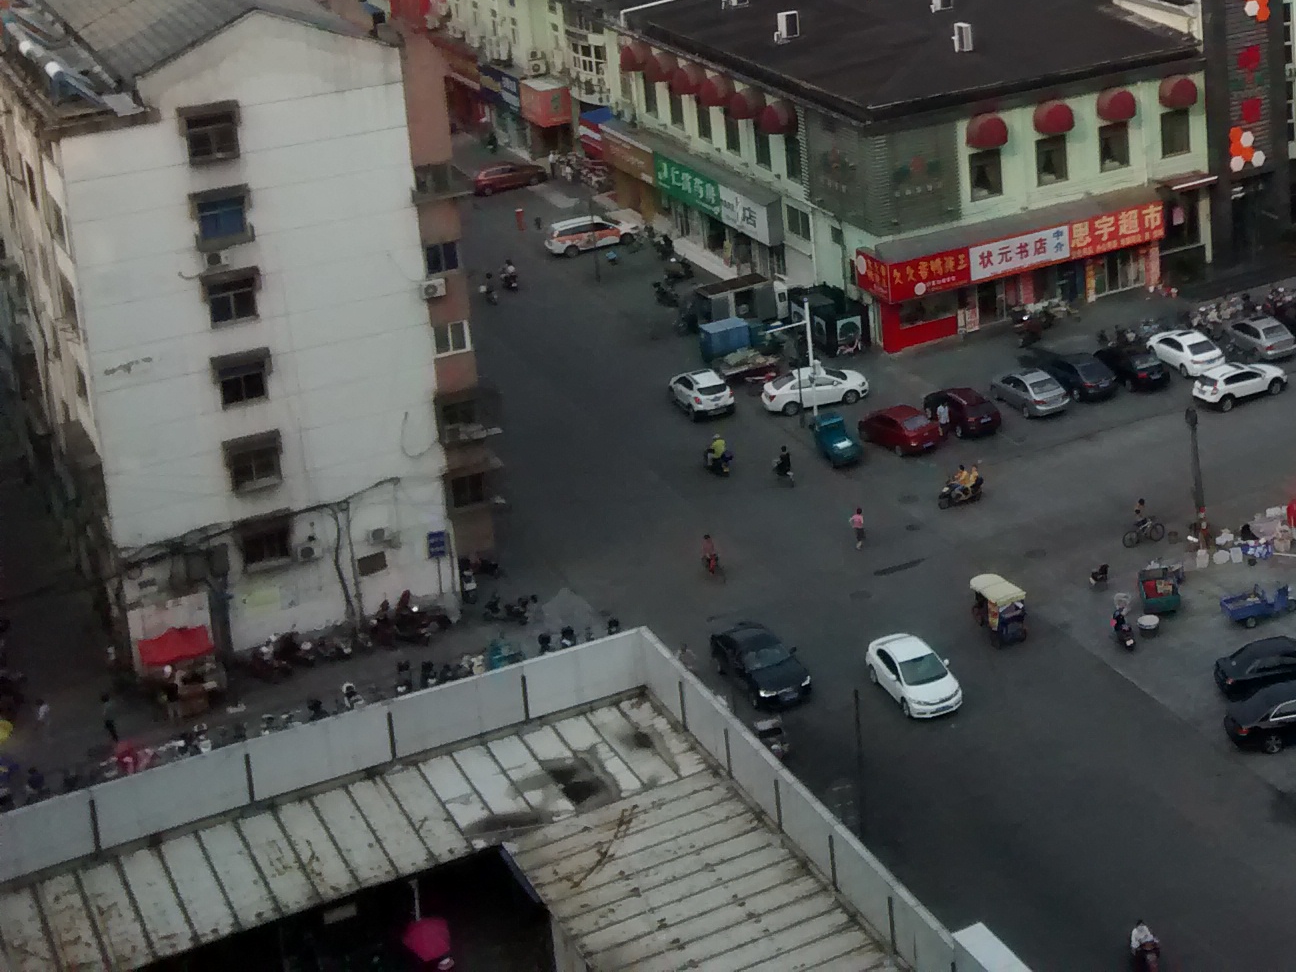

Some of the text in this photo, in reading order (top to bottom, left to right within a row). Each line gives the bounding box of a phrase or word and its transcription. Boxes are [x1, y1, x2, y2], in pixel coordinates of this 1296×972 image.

[978, 237, 1048, 269] 状元书店
[1052, 229, 1065, 253] 中介
